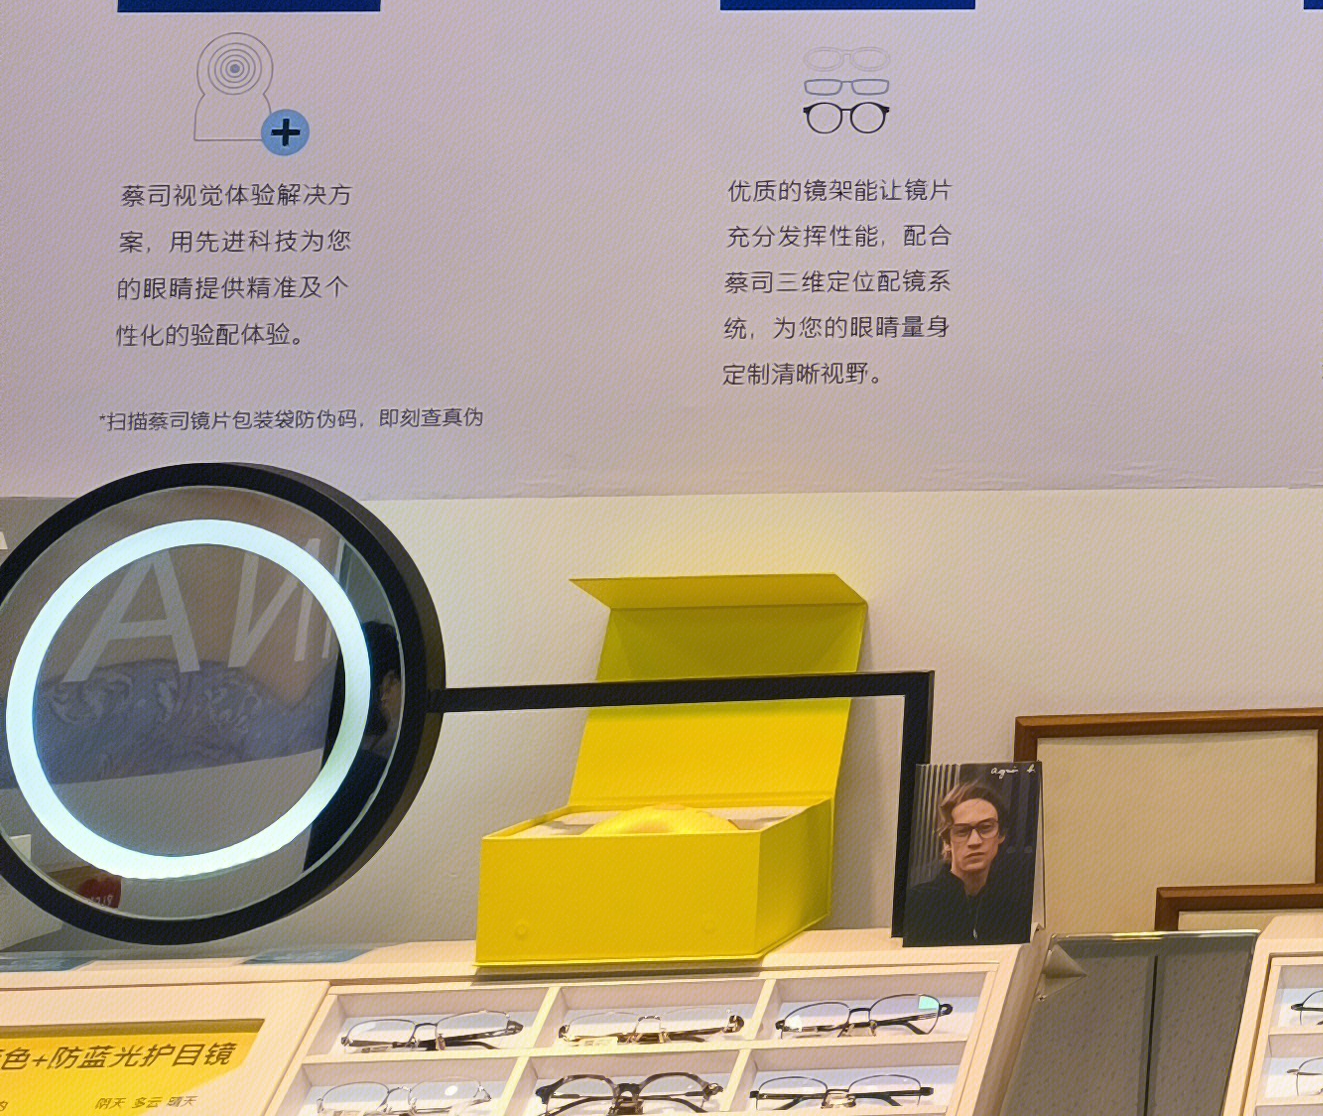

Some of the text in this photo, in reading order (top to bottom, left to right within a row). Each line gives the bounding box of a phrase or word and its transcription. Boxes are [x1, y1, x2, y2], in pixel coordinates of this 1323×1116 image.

[121, 183, 353, 207] 蔡司视觉体验解决方
[727, 178, 953, 202] 优质的镜架能让镜片
[118, 229, 352, 254] 案，用先进科技为您
[726, 224, 952, 248] 充分发挥性能，配合
[117, 275, 349, 300] 的眼睛提供精准及个
[724, 270, 951, 293] 蔡司三维定位配镜系
[116, 322, 303, 347] 性化的验配体验。
[723, 316, 949, 340] 统，为您的眼睛量身
[722, 362, 883, 386] 定制清晰视野。
[0, 1042, 238, 1071] 色+防蓝光护目镜
